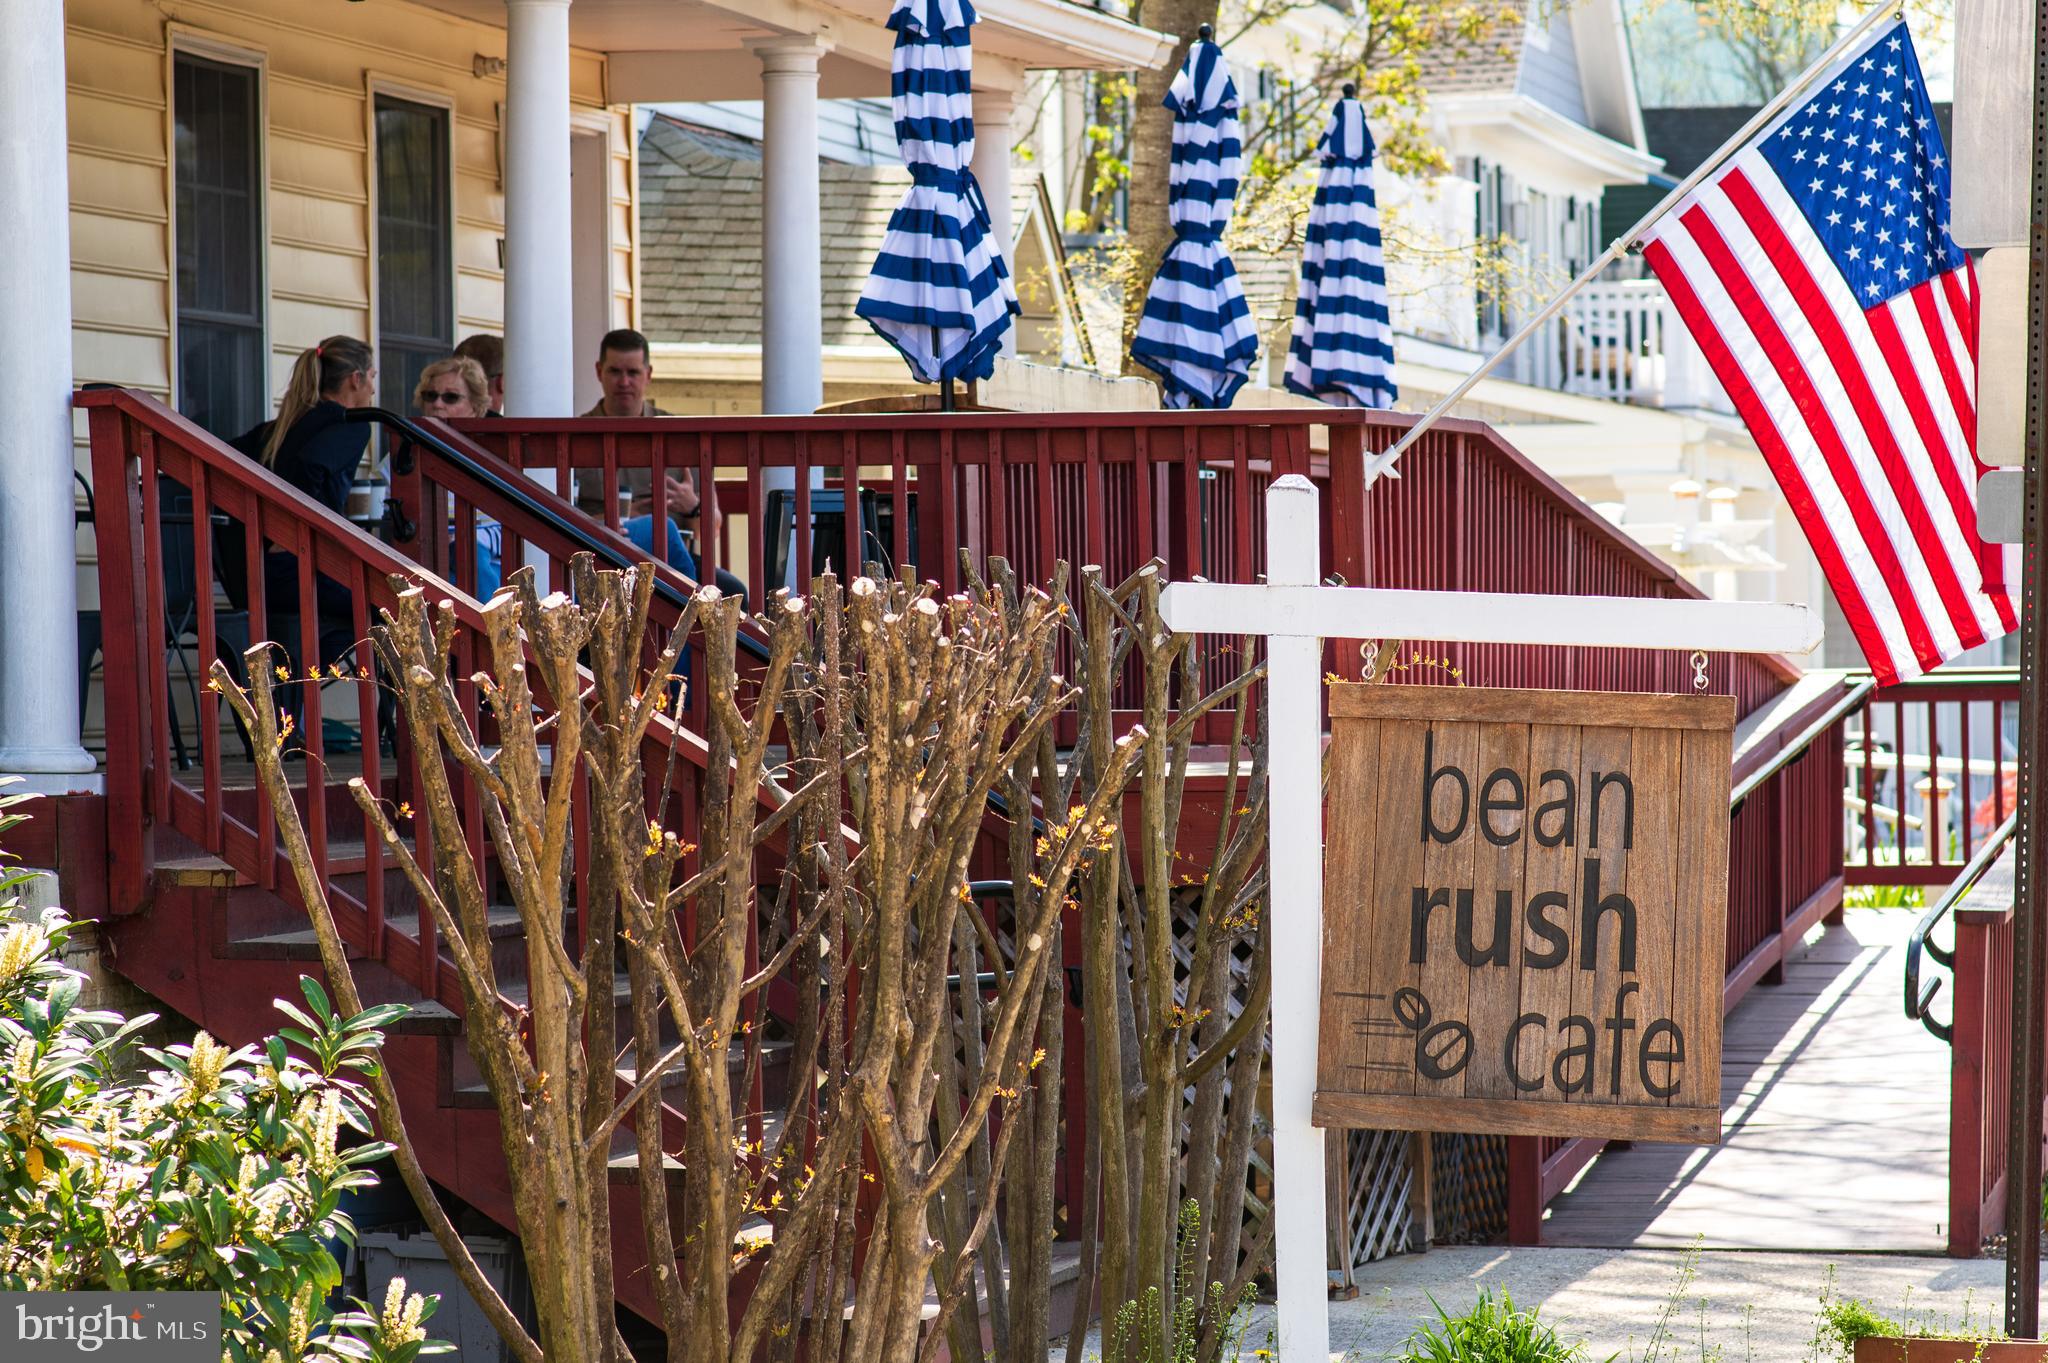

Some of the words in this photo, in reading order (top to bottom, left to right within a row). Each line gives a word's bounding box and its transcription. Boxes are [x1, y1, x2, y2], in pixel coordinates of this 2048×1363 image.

[1420, 731, 1634, 849] bean
[1409, 858, 1637, 972] rush
[1504, 983, 1685, 1097] cafe
